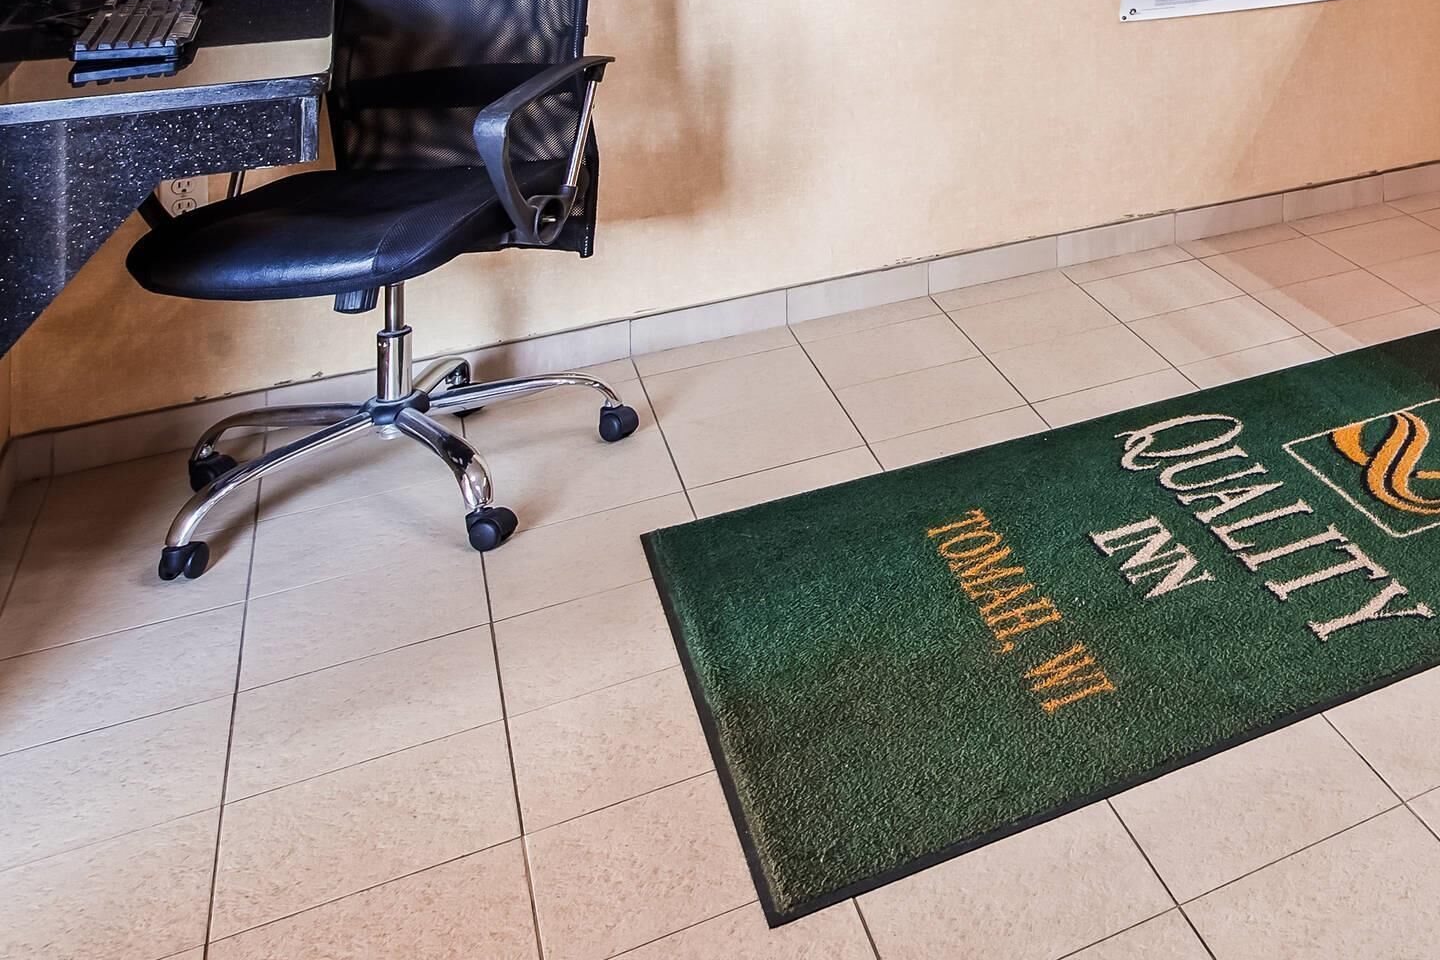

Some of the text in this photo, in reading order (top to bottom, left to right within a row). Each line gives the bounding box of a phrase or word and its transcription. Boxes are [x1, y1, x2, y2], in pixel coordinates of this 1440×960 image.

[926, 508, 1118, 715] TOMAH, WI
[1089, 515, 1217, 600] INN
[1114, 413, 1437, 642] QUALITY
